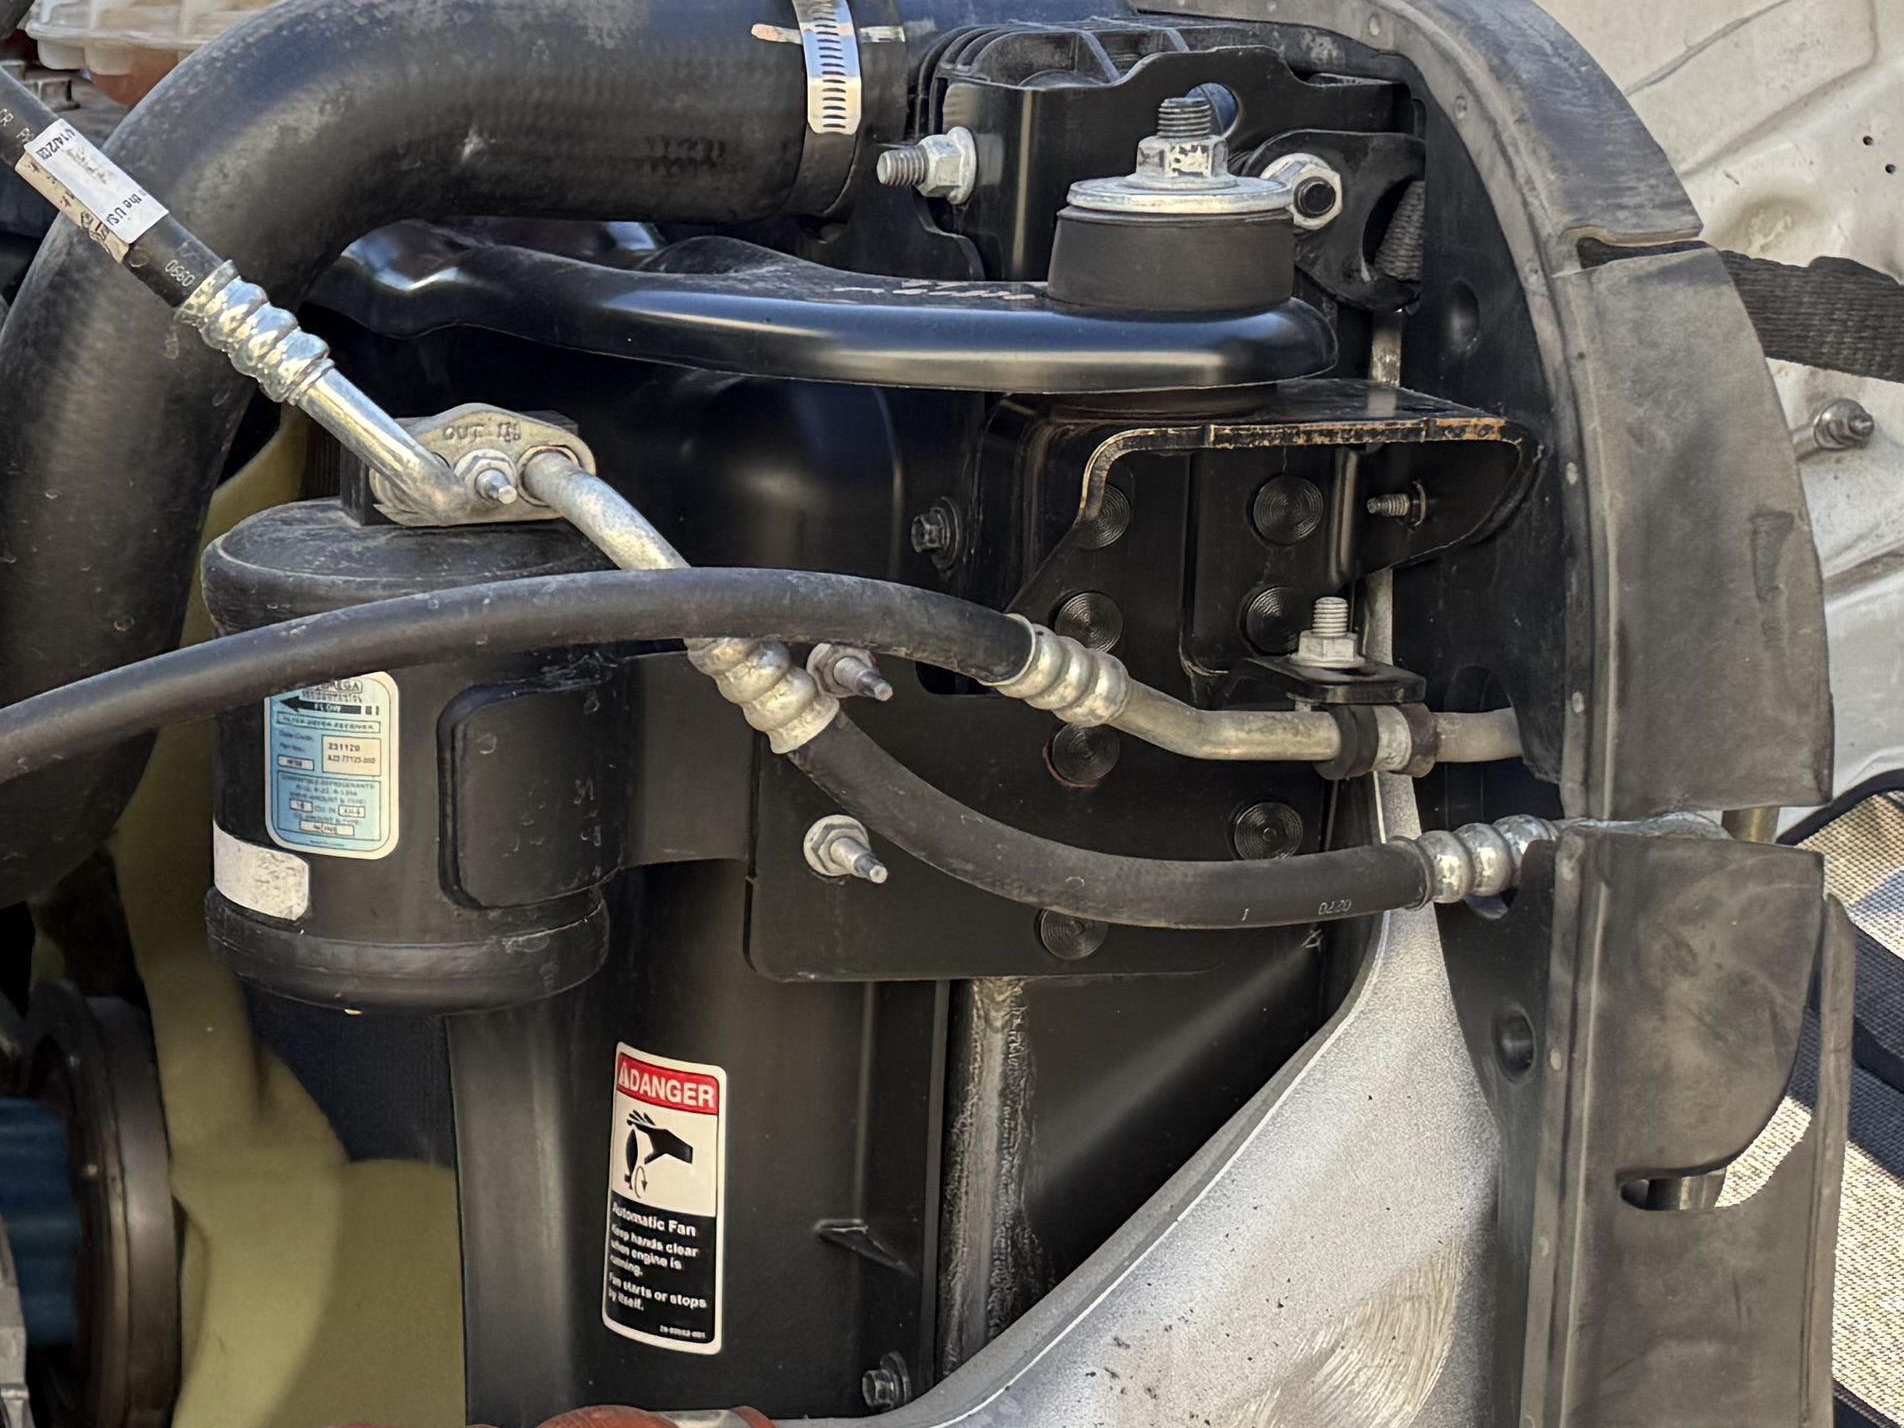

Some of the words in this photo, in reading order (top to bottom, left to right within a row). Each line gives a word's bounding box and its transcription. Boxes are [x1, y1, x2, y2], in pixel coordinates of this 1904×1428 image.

[124, 192, 143, 210] the
[442, 423, 485, 443] OUT
[314, 703, 342, 713] FLOW
[629, 1069, 716, 1109] DANGER
[612, 1201, 665, 1231] Automatic
[668, 1220, 697, 1237] Fan
[611, 1223, 630, 1241] Keep
[630, 1231, 664, 1251] hands
[665, 1243, 699, 1258] clear
[631, 1248, 669, 1268] engine
[670, 1256, 683, 1271] is
[609, 1271, 622, 1288] Fan
[622, 1279, 653, 1299] starts
[654, 1290, 669, 1302] or
[669, 1293, 708, 1310] stops
